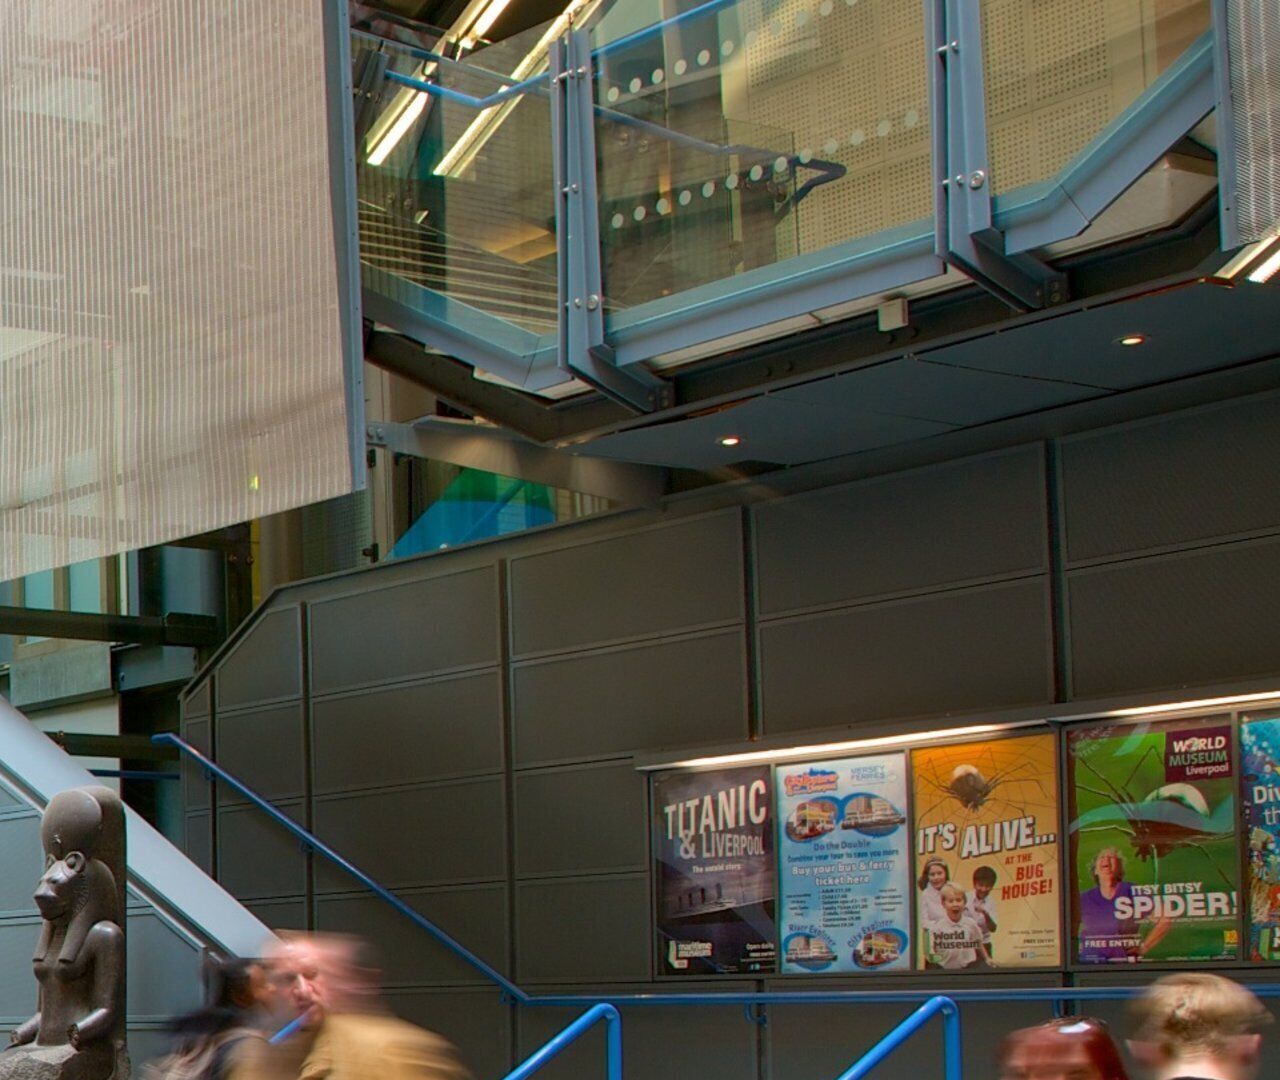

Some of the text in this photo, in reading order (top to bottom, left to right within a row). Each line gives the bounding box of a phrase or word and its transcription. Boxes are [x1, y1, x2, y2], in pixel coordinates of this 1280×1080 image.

[1173, 736, 1226, 753] WORLD
[1169, 751, 1228, 767] MUSEUM
[1186, 763, 1229, 776] Liverpool
[664, 779, 767, 840] TITANIC
[680, 829, 697, 860] &
[702, 831, 766, 859] LIVERPOOL
[918, 815, 1056, 860] IT'S ALIVE...
[1005, 853, 1033, 865] AT THE
[692, 865, 704, 873] The
[791, 866, 811, 876] Buy
[813, 864, 836, 875] your
[838, 861, 857, 872] bus
[1016, 863, 1045, 881] BUG
[815, 875, 846, 886] ticket
[1001, 879, 1053, 901] HOUSE!
[1131, 882, 1202, 896] ITSY BITSY
[1114, 891, 1239, 920] SPIDER!
[933, 930, 966, 941] World
[933, 940, 981, 950] Museum
[1084, 940, 1107, 949] FREE
